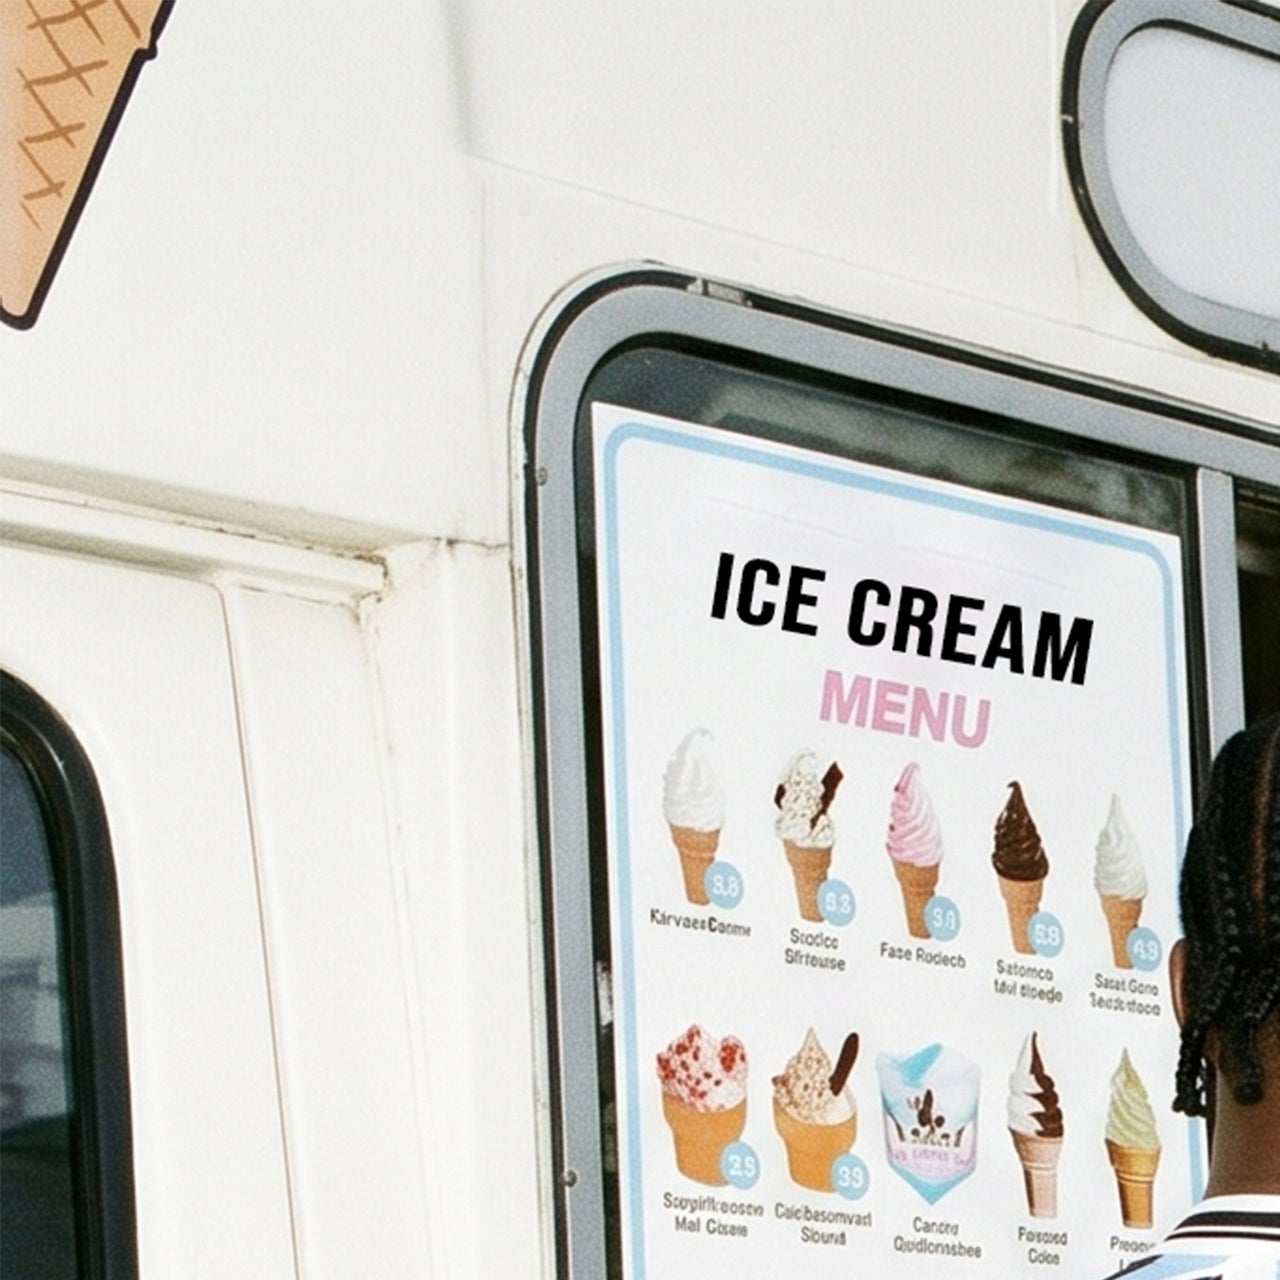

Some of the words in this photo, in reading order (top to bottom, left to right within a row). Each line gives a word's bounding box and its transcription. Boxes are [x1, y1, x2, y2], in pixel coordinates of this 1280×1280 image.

[710, 552, 826, 637] ICE
[847, 578, 1094, 686] CREAM
[819, 669, 991, 750] MENU
